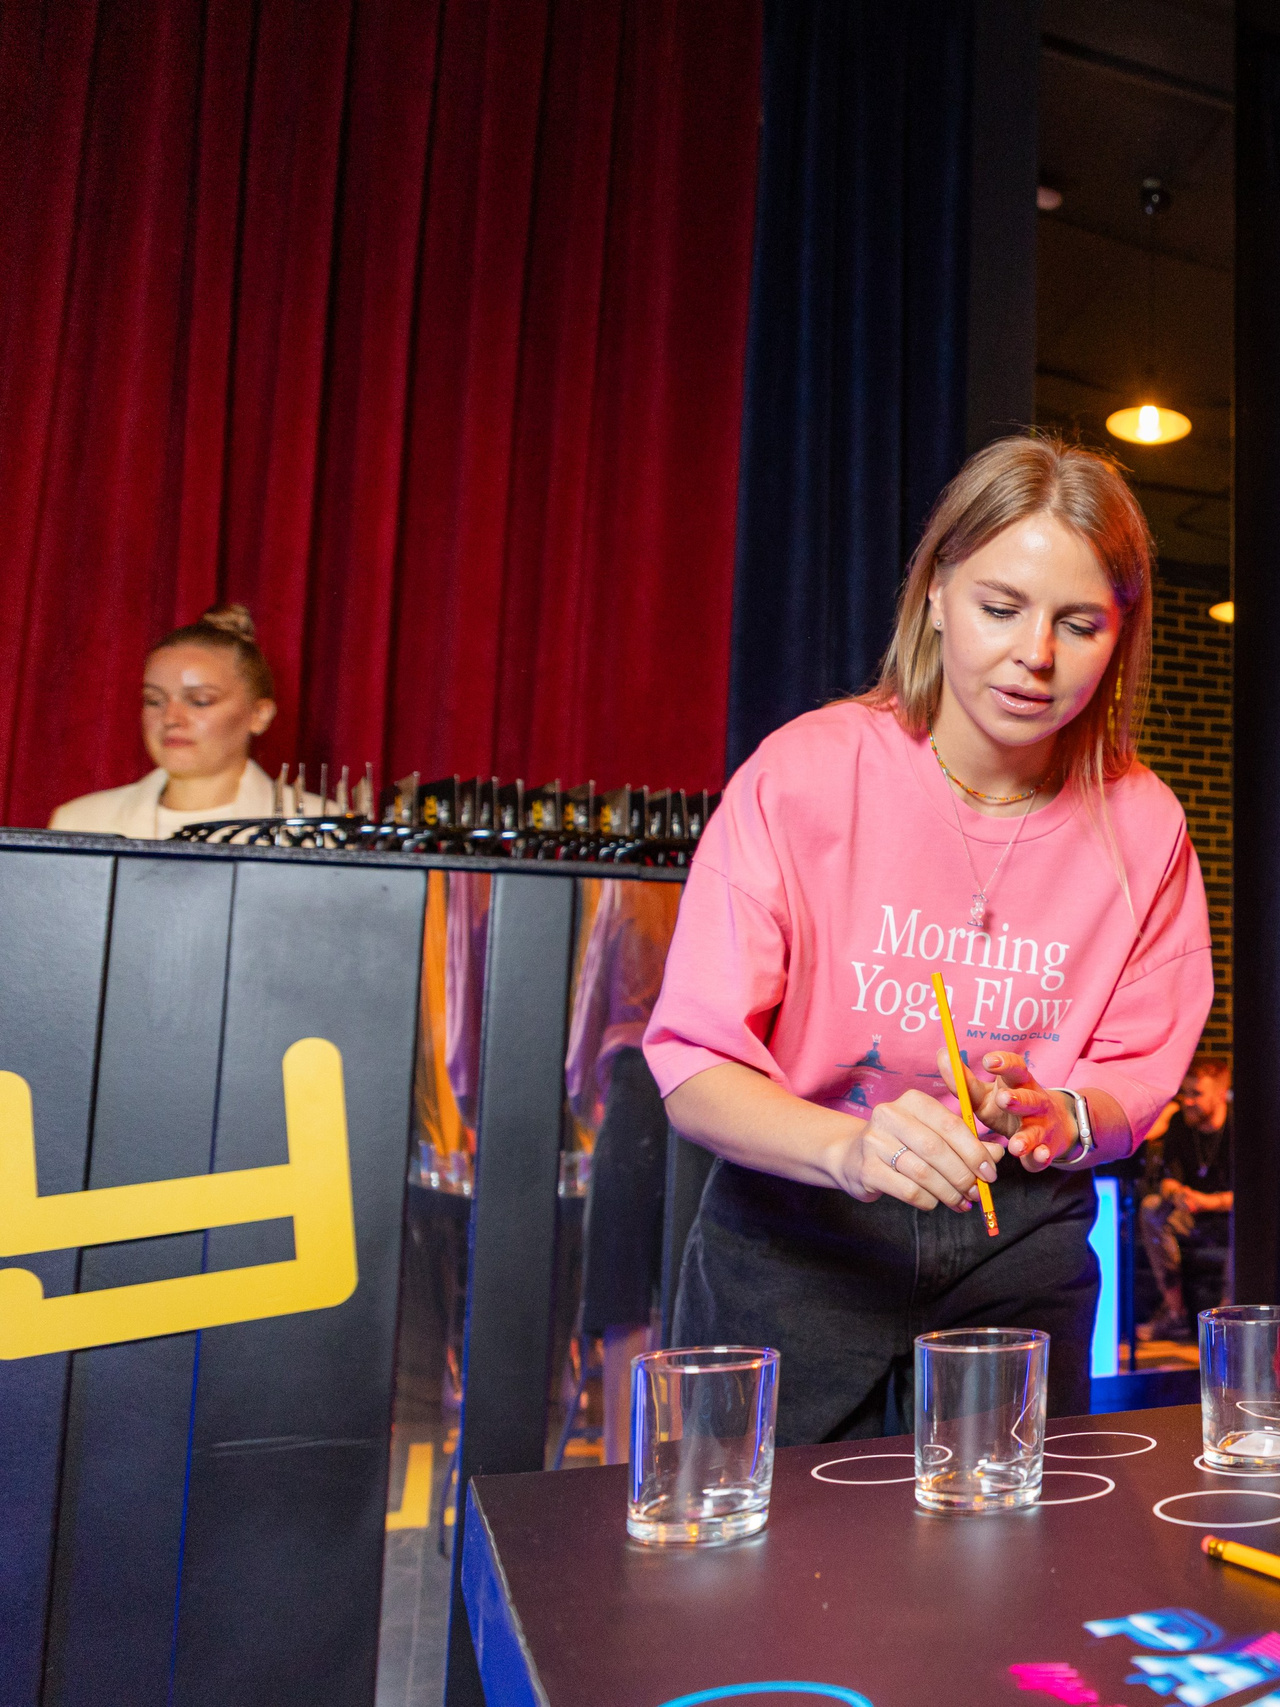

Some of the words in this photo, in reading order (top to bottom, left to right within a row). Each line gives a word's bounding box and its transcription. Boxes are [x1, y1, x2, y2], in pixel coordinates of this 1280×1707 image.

[873, 904, 1069, 991] Morning
[967, 976, 1073, 1031] Flow
[966, 1029, 987, 1039] MY
[990, 1032, 1027, 1042] MOOD
[1029, 1032, 1060, 1042] CLUB
